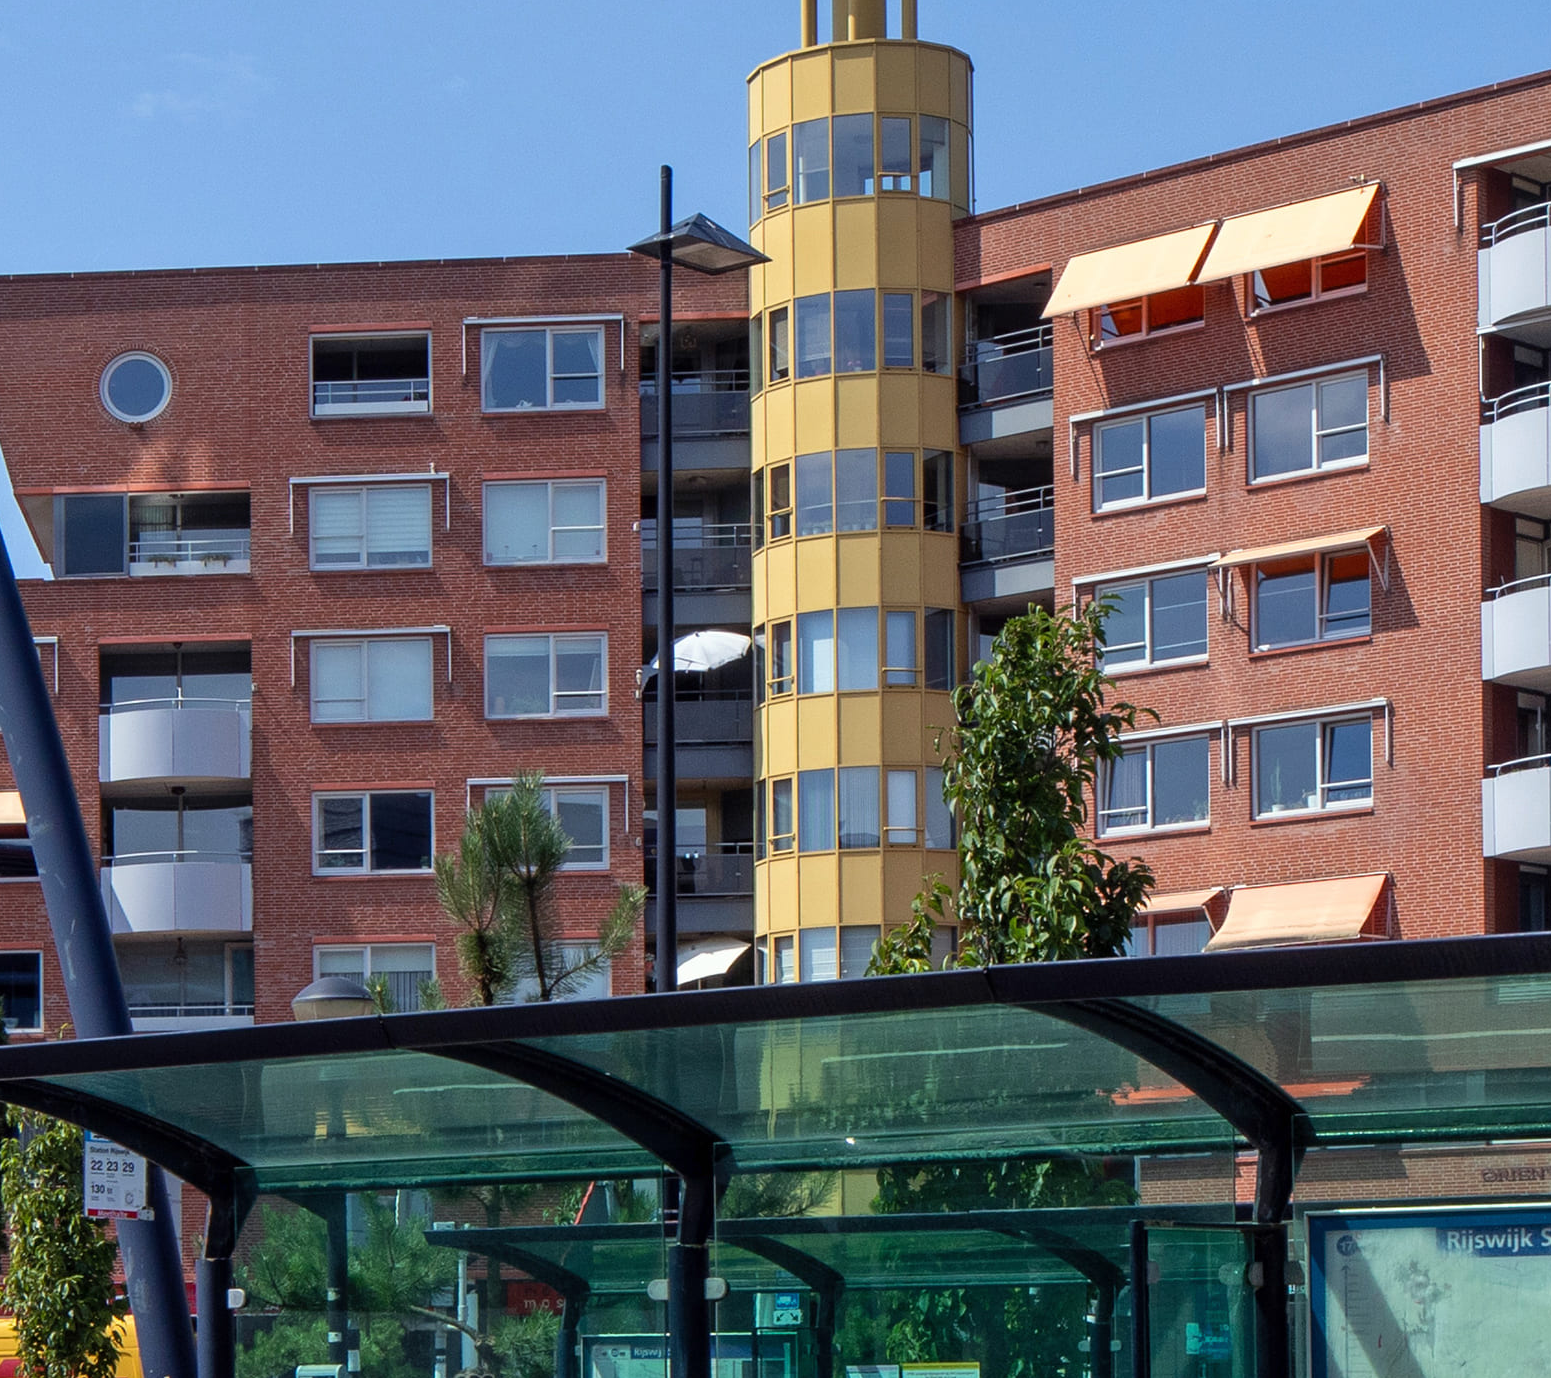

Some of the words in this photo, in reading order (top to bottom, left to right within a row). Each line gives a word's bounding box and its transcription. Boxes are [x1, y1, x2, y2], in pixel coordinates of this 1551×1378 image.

[90, 1159, 103, 1171] 22
[106, 1160, 118, 1172] 23
[122, 1162, 135, 1173] 29
[91, 1184, 106, 1194] 130
[1447, 1227, 1533, 1254] Rijswijk
